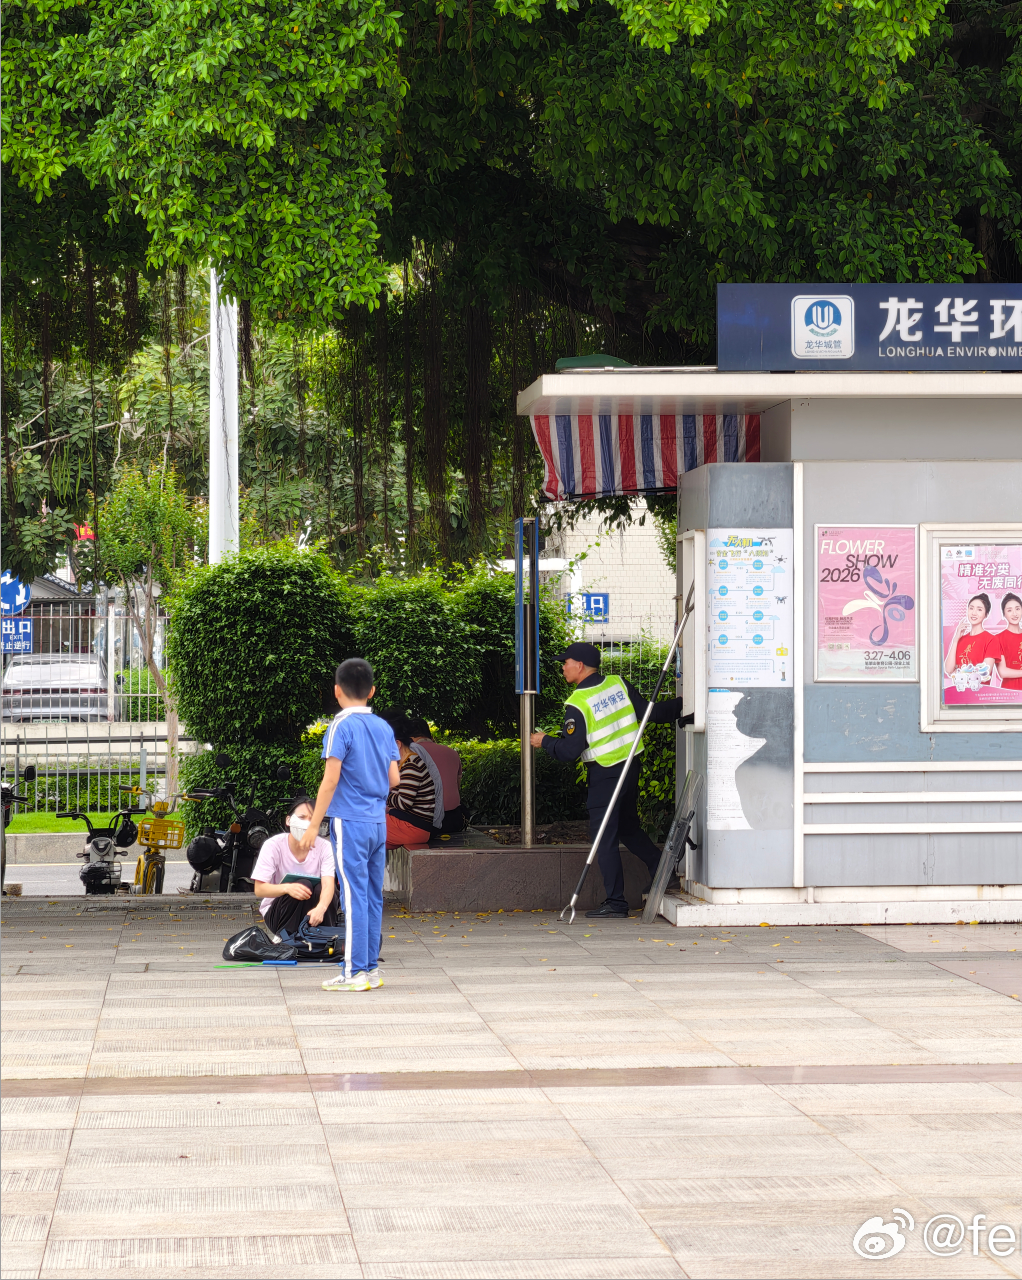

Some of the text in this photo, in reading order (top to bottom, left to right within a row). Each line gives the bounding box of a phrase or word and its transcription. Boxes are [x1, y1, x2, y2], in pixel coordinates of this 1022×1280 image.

[804, 340, 842, 350] 龙华城管
[878, 346, 944, 357] LONGHUA
[726, 535, 753, 548] 无人机
[820, 539, 885, 555] FLOWER
[845, 554, 899, 569] SHOW
[820, 567, 861, 583] 2026
[959, 563, 1010, 577] 精准分类
[2, 620, 31, 634] 出口
[592, 690, 626, 715] 龙华保安
